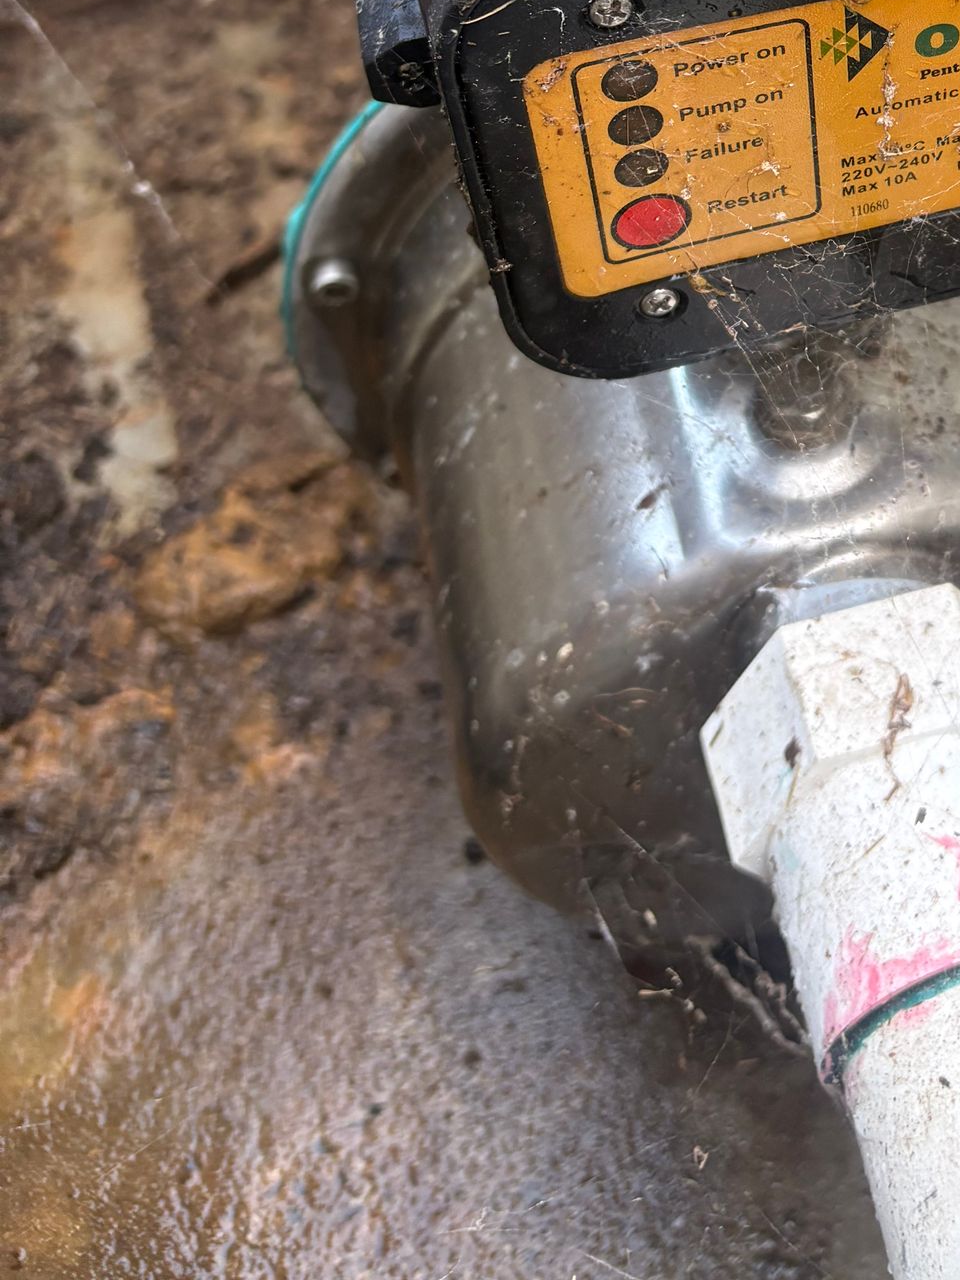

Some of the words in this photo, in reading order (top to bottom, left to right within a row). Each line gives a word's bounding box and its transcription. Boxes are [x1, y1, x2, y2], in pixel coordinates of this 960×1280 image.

[673, 51, 749, 78] Power
[756, 43, 787, 61] on
[679, 96, 748, 122] Pump
[754, 89, 784, 105] on
[854, 88, 960, 120] Auomatic
[685, 136, 764, 164] Failure
[841, 153, 878, 169] Max
[841, 150, 943, 183] 220V~240V
[707, 184, 788, 214] Restart
[841, 181, 879, 198] Max
[884, 171, 918, 187] 10A
[850, 198, 890, 217] 110680
